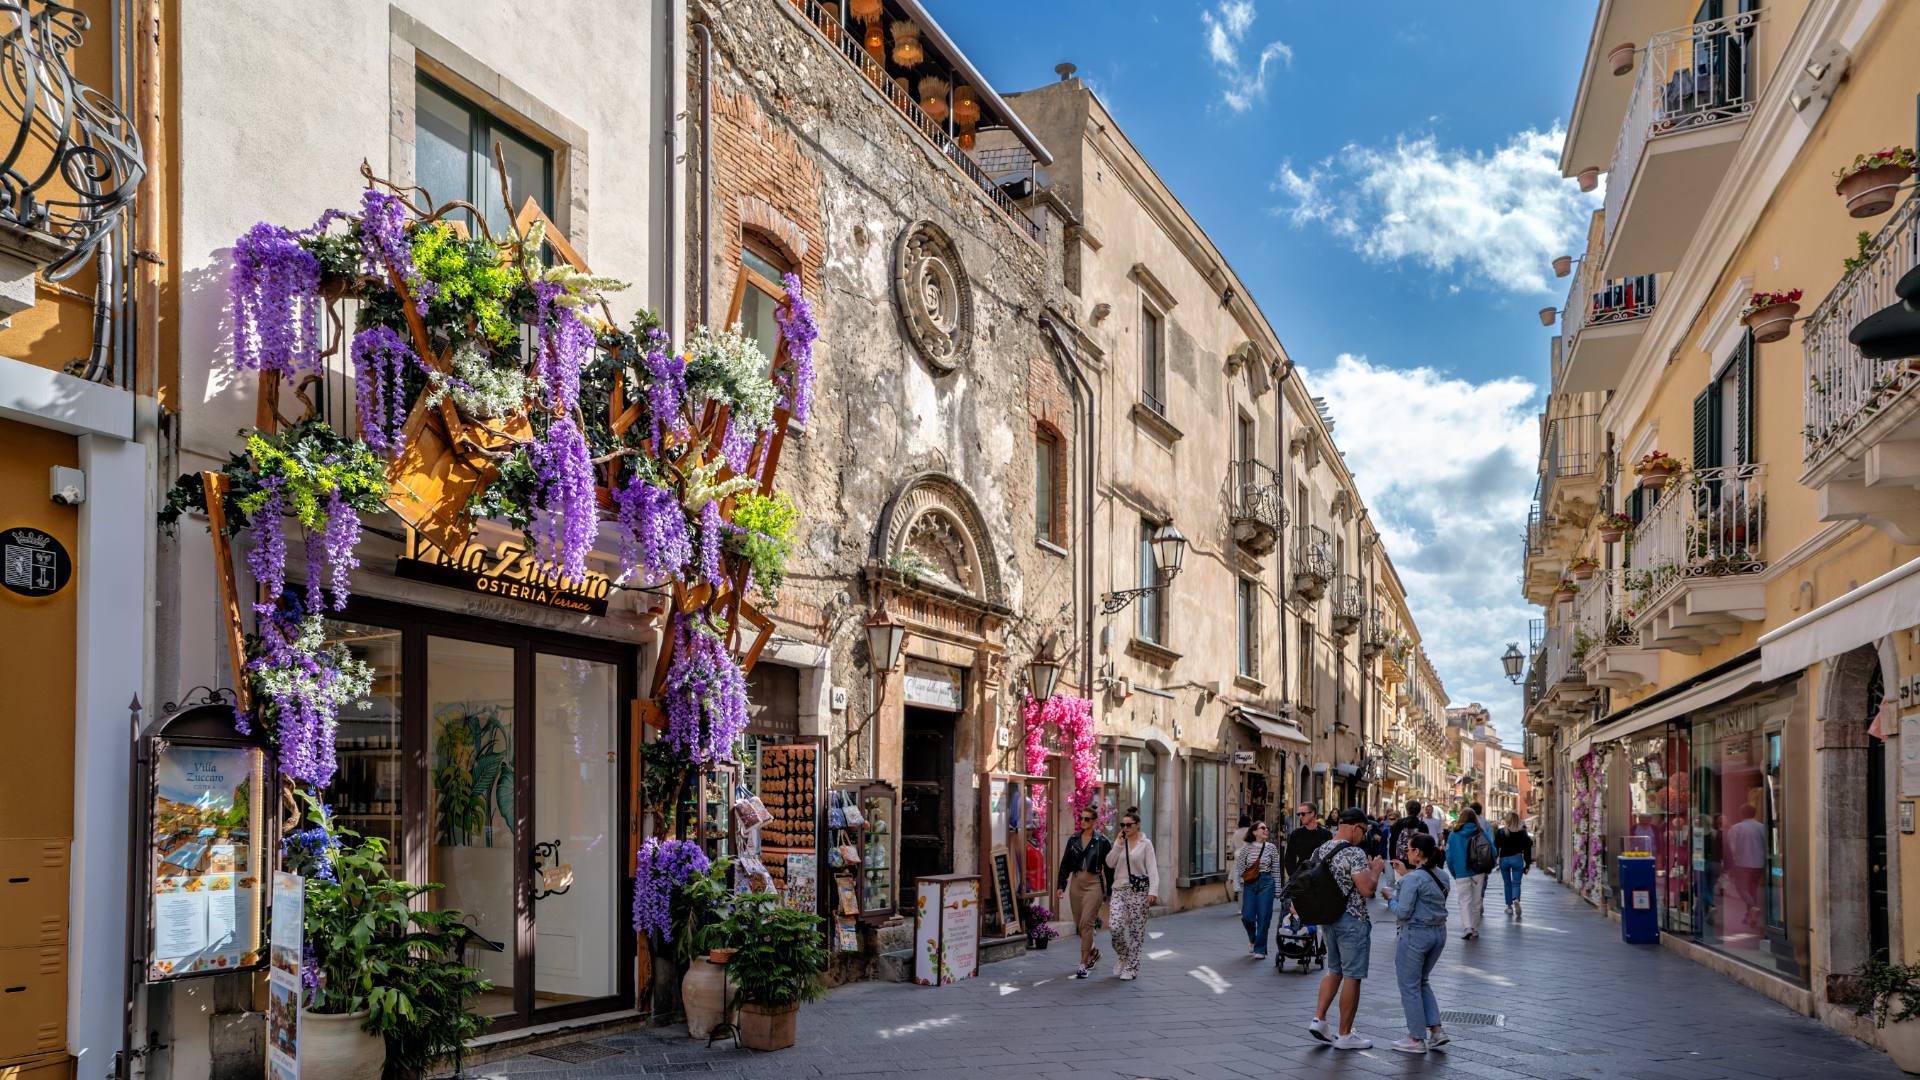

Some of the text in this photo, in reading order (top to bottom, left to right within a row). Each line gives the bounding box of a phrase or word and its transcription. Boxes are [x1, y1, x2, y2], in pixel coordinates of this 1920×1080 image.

[476, 577, 547, 603] OSTERIA
[549, 588, 592, 612] Terrace
[834, 692, 844, 703] 40
[193, 761, 217, 772] Villa
[186, 772, 224, 782] Zuccaro
